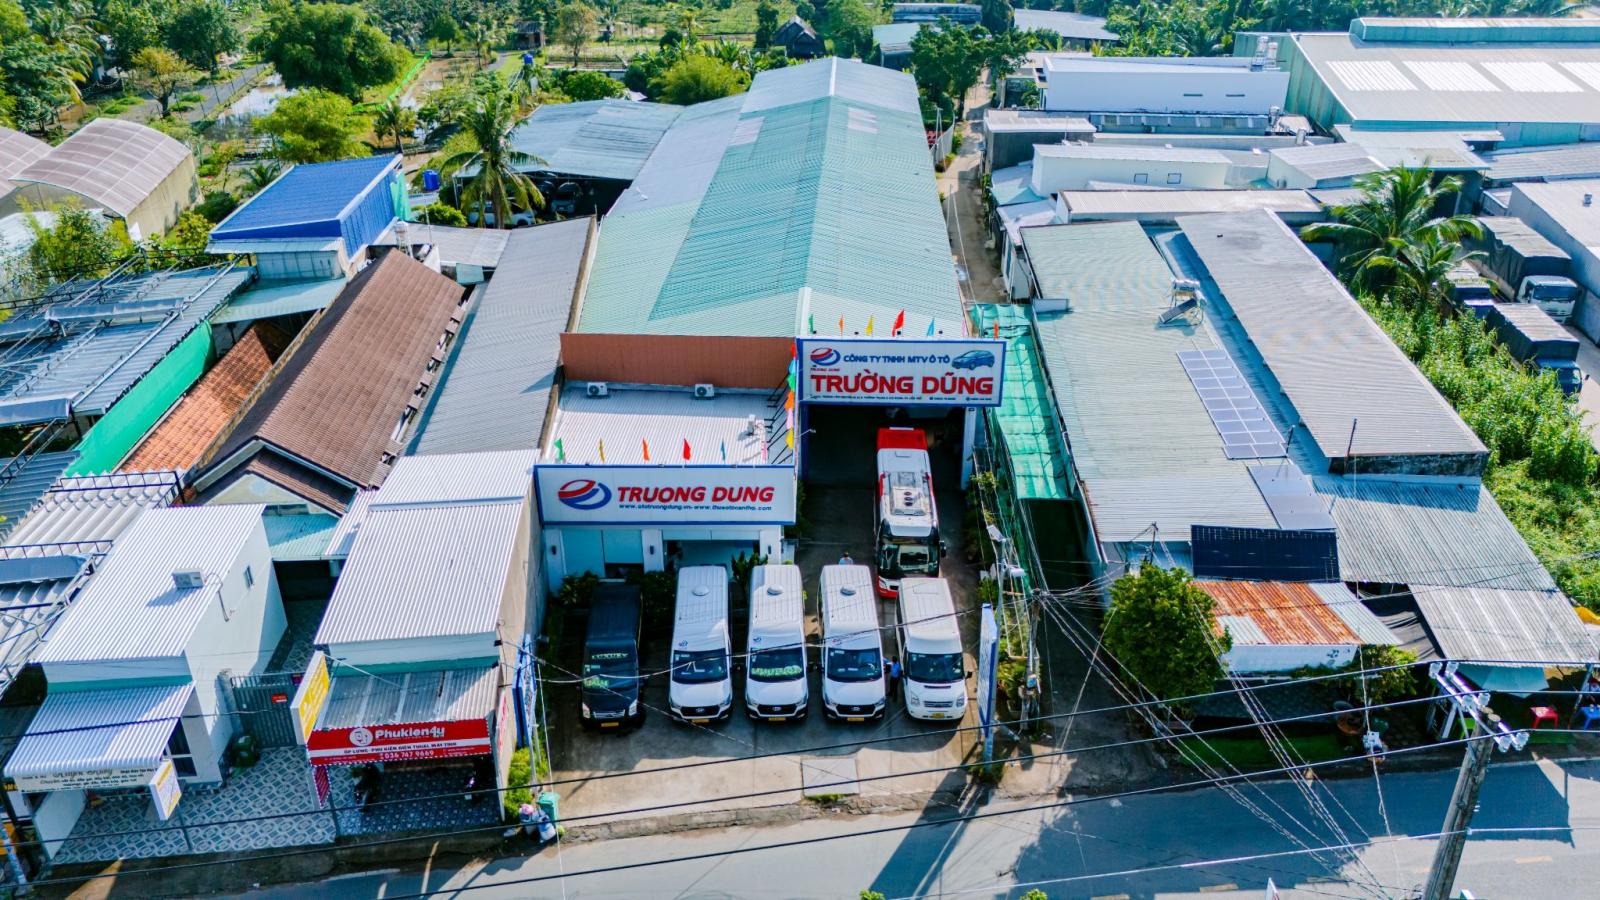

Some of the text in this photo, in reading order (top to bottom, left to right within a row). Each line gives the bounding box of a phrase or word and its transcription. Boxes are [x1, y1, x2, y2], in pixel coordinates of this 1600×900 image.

[844, 353, 950, 364] CÔNG TY TNHH MTV Ô TÔ
[810, 369, 994, 395] TRƯỜNG DŨNG
[617, 486, 775, 503] TRUONG DUNG
